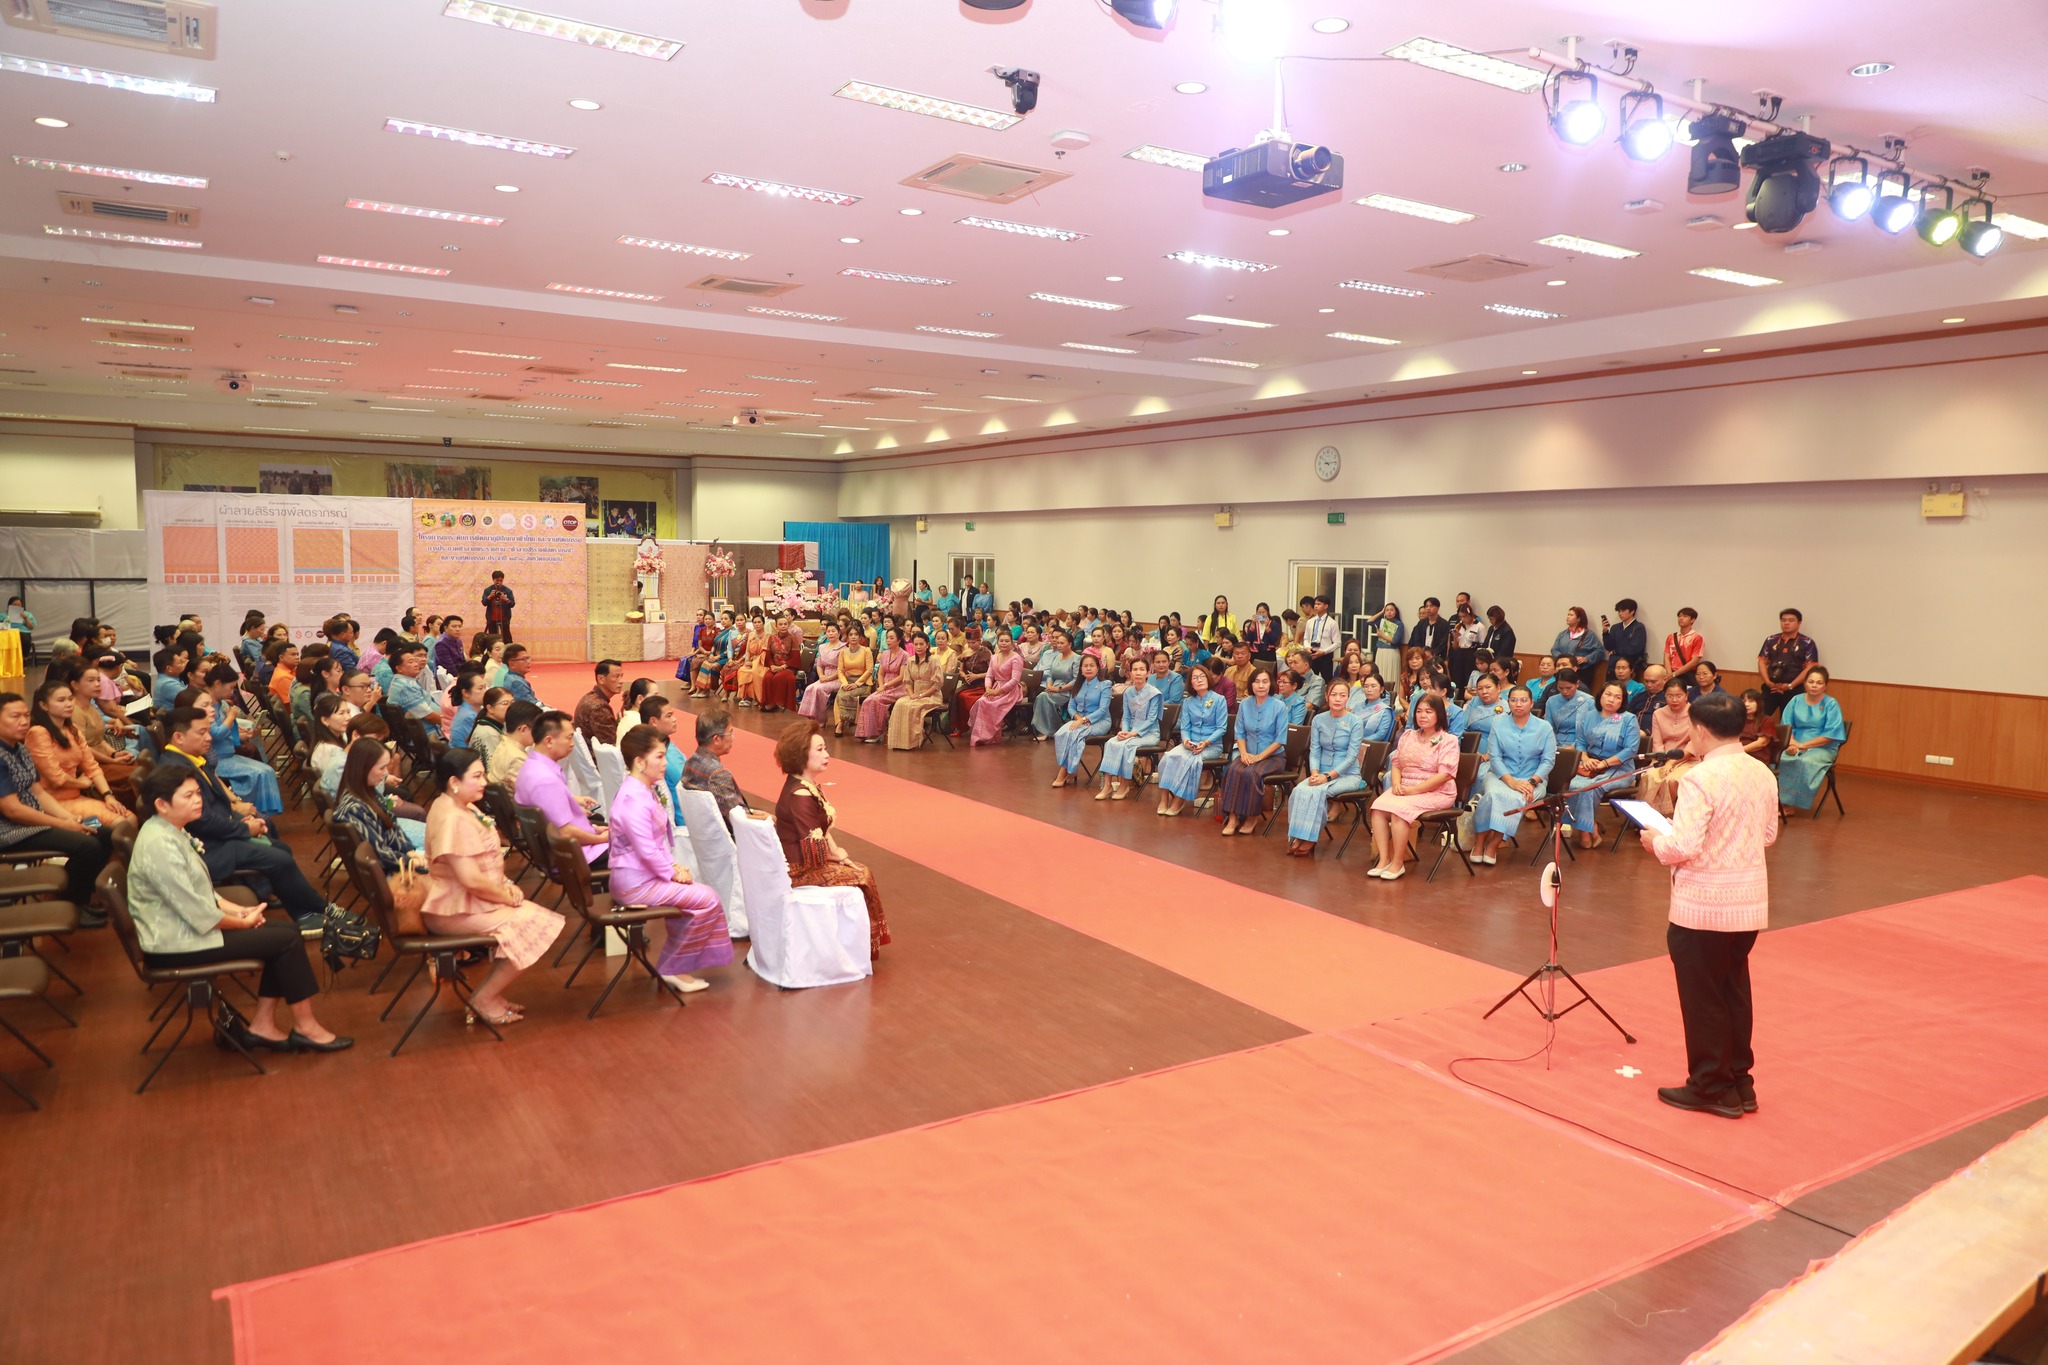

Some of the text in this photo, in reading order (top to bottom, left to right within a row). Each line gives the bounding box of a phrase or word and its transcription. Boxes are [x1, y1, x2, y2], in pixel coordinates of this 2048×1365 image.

[219, 504, 348, 518] ผ้าลายสิริราชพัสตราภรณ์
